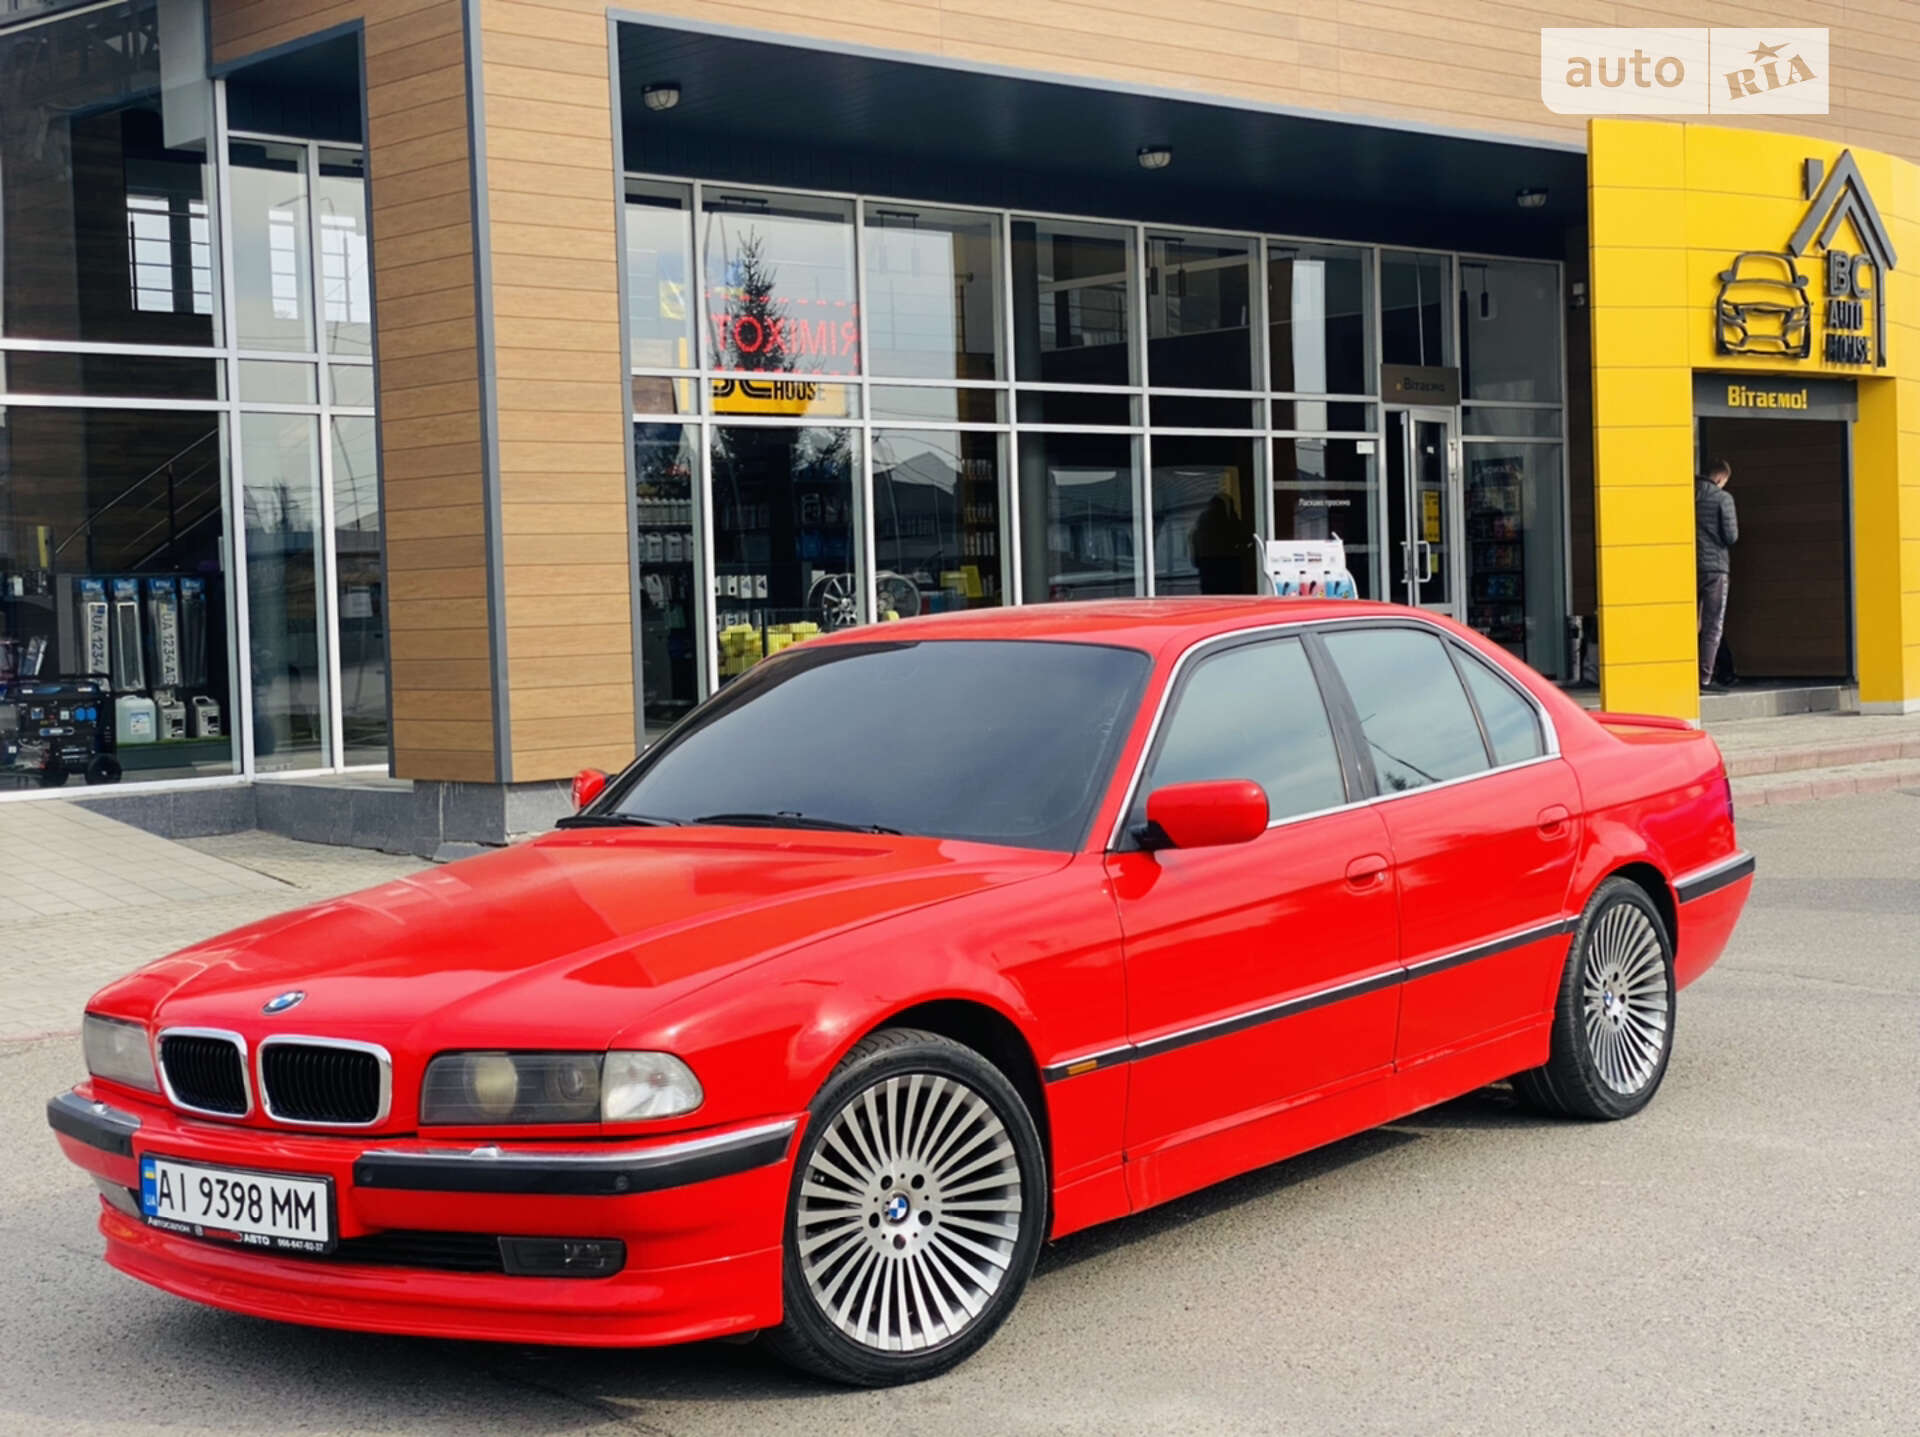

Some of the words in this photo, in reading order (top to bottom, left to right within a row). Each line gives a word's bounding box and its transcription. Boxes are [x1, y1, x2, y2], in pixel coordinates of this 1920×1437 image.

[1826, 250, 1873, 299] BC
[1827, 300, 1863, 330] AUTO
[705, 314, 859, 356] ТОХІМІЯ
[1826, 333, 1872, 364] HOUSE
[1727, 385, 1808, 409] Вітаємо!
[92, 635, 104, 666] 1234
[162, 633, 176, 663] 1234
[145, 1193, 155, 1206] UA
[159, 1169, 187, 1212] AI
[199, 1176, 263, 1224] 9398
[270, 1186, 316, 1232] MM
